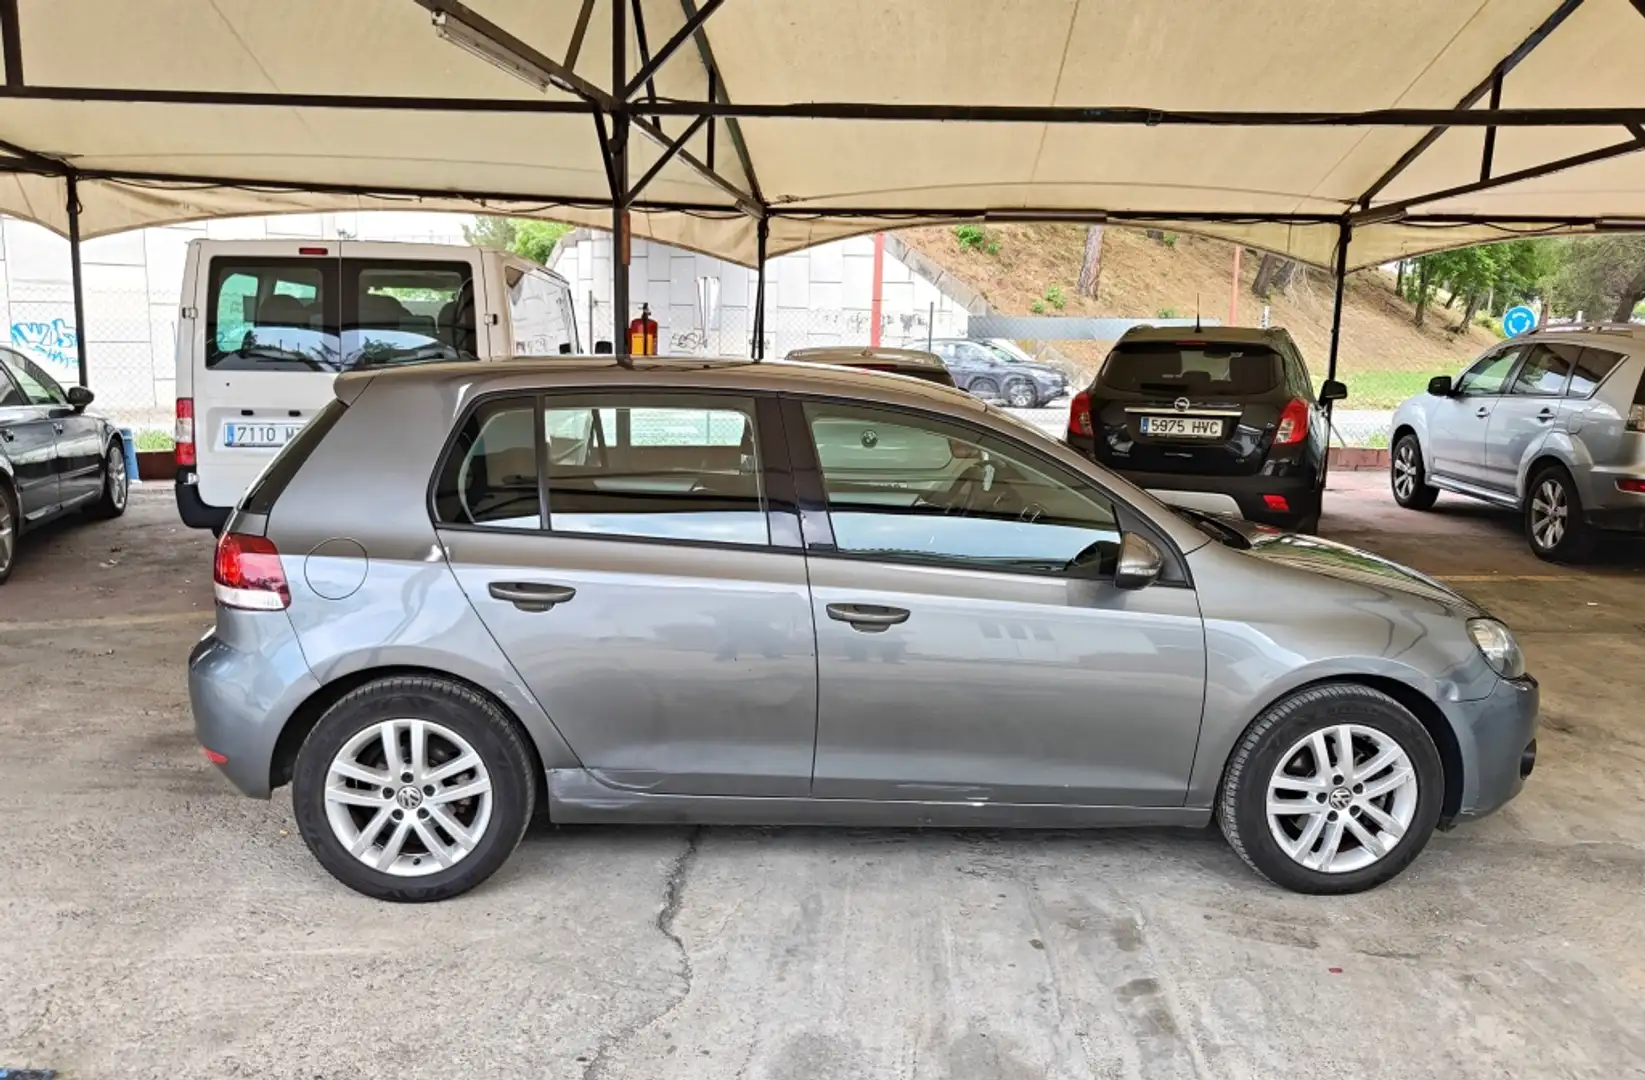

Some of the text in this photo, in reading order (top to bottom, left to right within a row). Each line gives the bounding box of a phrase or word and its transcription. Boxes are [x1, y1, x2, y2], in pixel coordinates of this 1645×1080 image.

[1151, 419, 1219, 434] 5975 HVC
[237, 427, 276, 442] 7110
